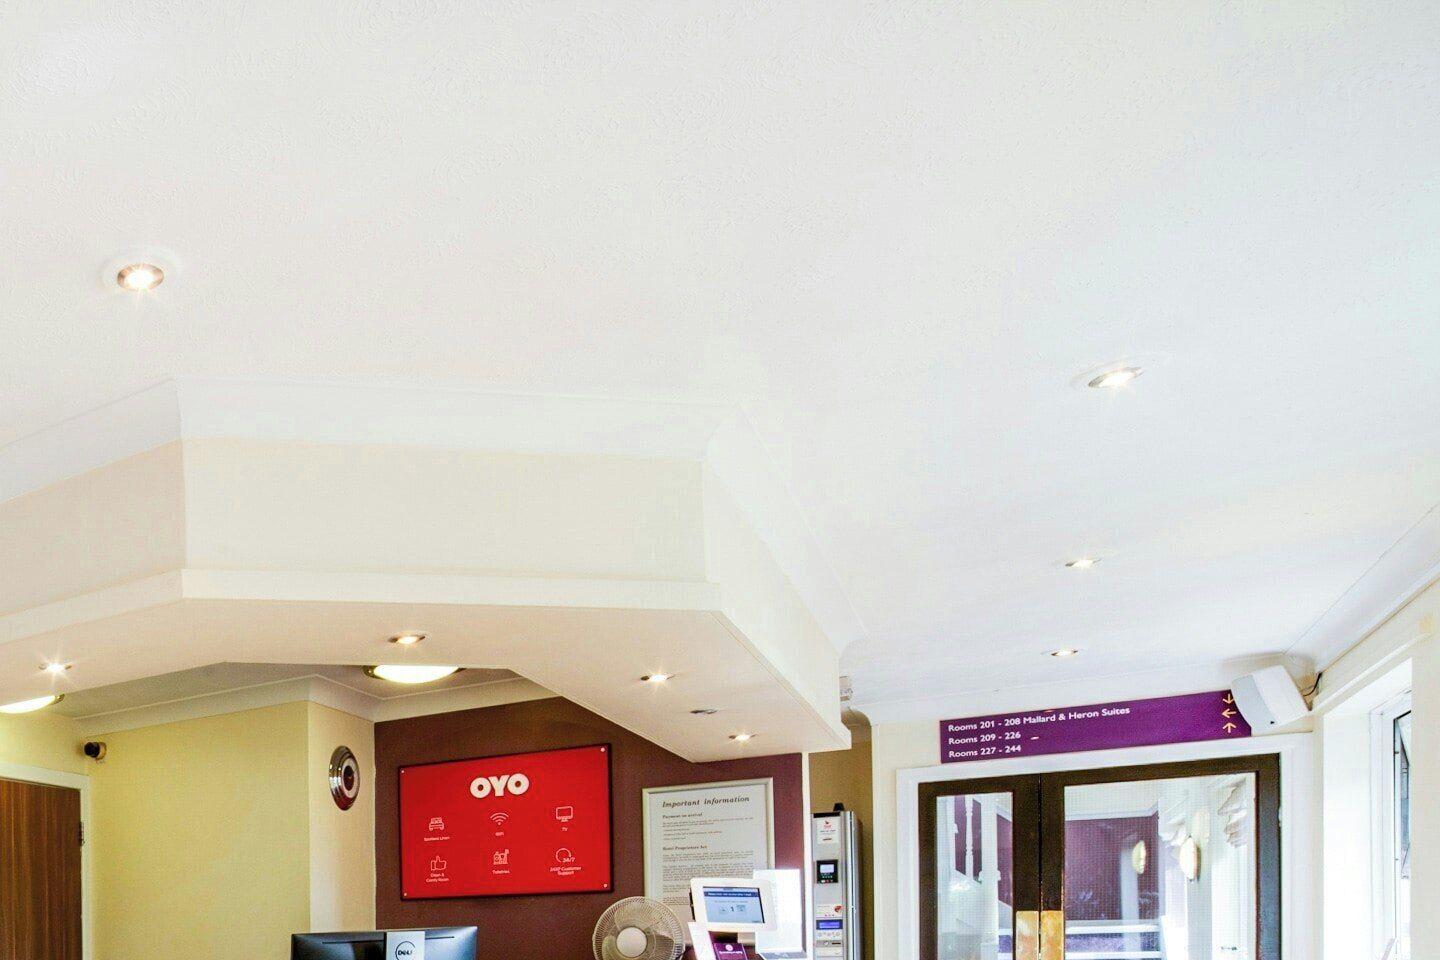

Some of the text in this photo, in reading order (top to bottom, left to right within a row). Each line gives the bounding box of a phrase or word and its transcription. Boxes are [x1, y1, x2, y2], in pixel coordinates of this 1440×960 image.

[948, 724, 978, 732] Rooms
[980, 721, 995, 729] 201
[1004, 717, 1021, 726] 208
[1023, 714, 1056, 724] Mallard
[1058, 713, 1066, 721] &
[1068, 711, 1100, 720] Heron
[1101, 707, 1131, 717] Suites
[948, 737, 978, 745] Rooms
[980, 733, 996, 742] 209
[1004, 731, 1021, 740] 226
[948, 750, 978, 758] Rooms
[980, 747, 996, 755] 227
[1005, 744, 1022, 753] 244
[470, 773, 530, 799] OYO
[662, 796, 750, 808] Important information
